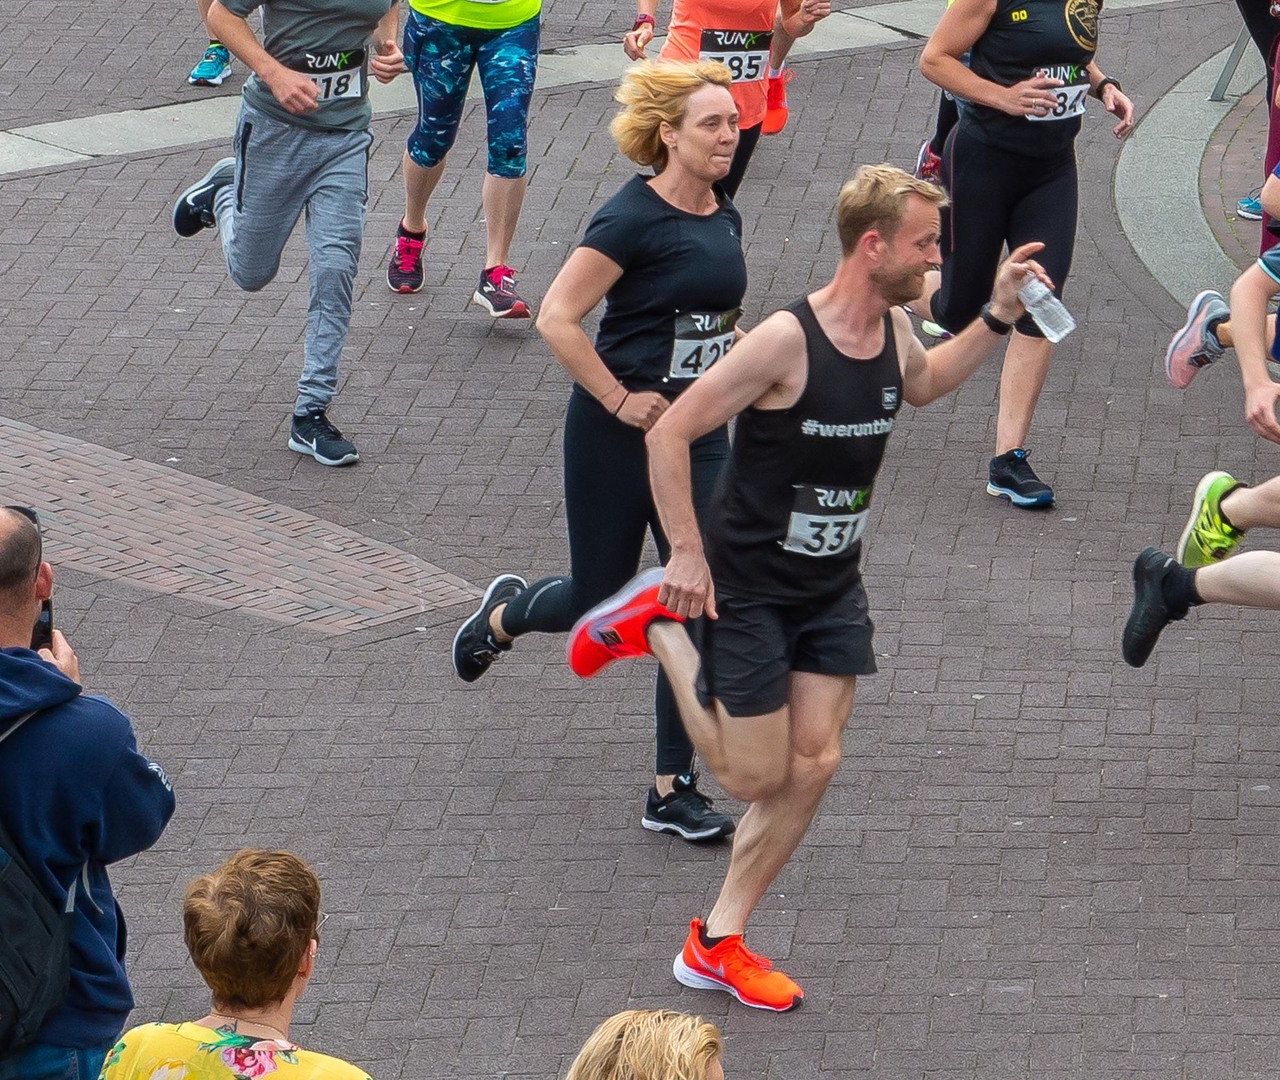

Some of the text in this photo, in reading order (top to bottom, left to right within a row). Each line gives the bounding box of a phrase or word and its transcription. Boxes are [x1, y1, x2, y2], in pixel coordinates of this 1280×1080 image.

[714, 31, 767, 49] RUNX
[305, 50, 358, 70] RUNX
[815, 487, 870, 511] RUNX
[804, 520, 859, 553] 331
